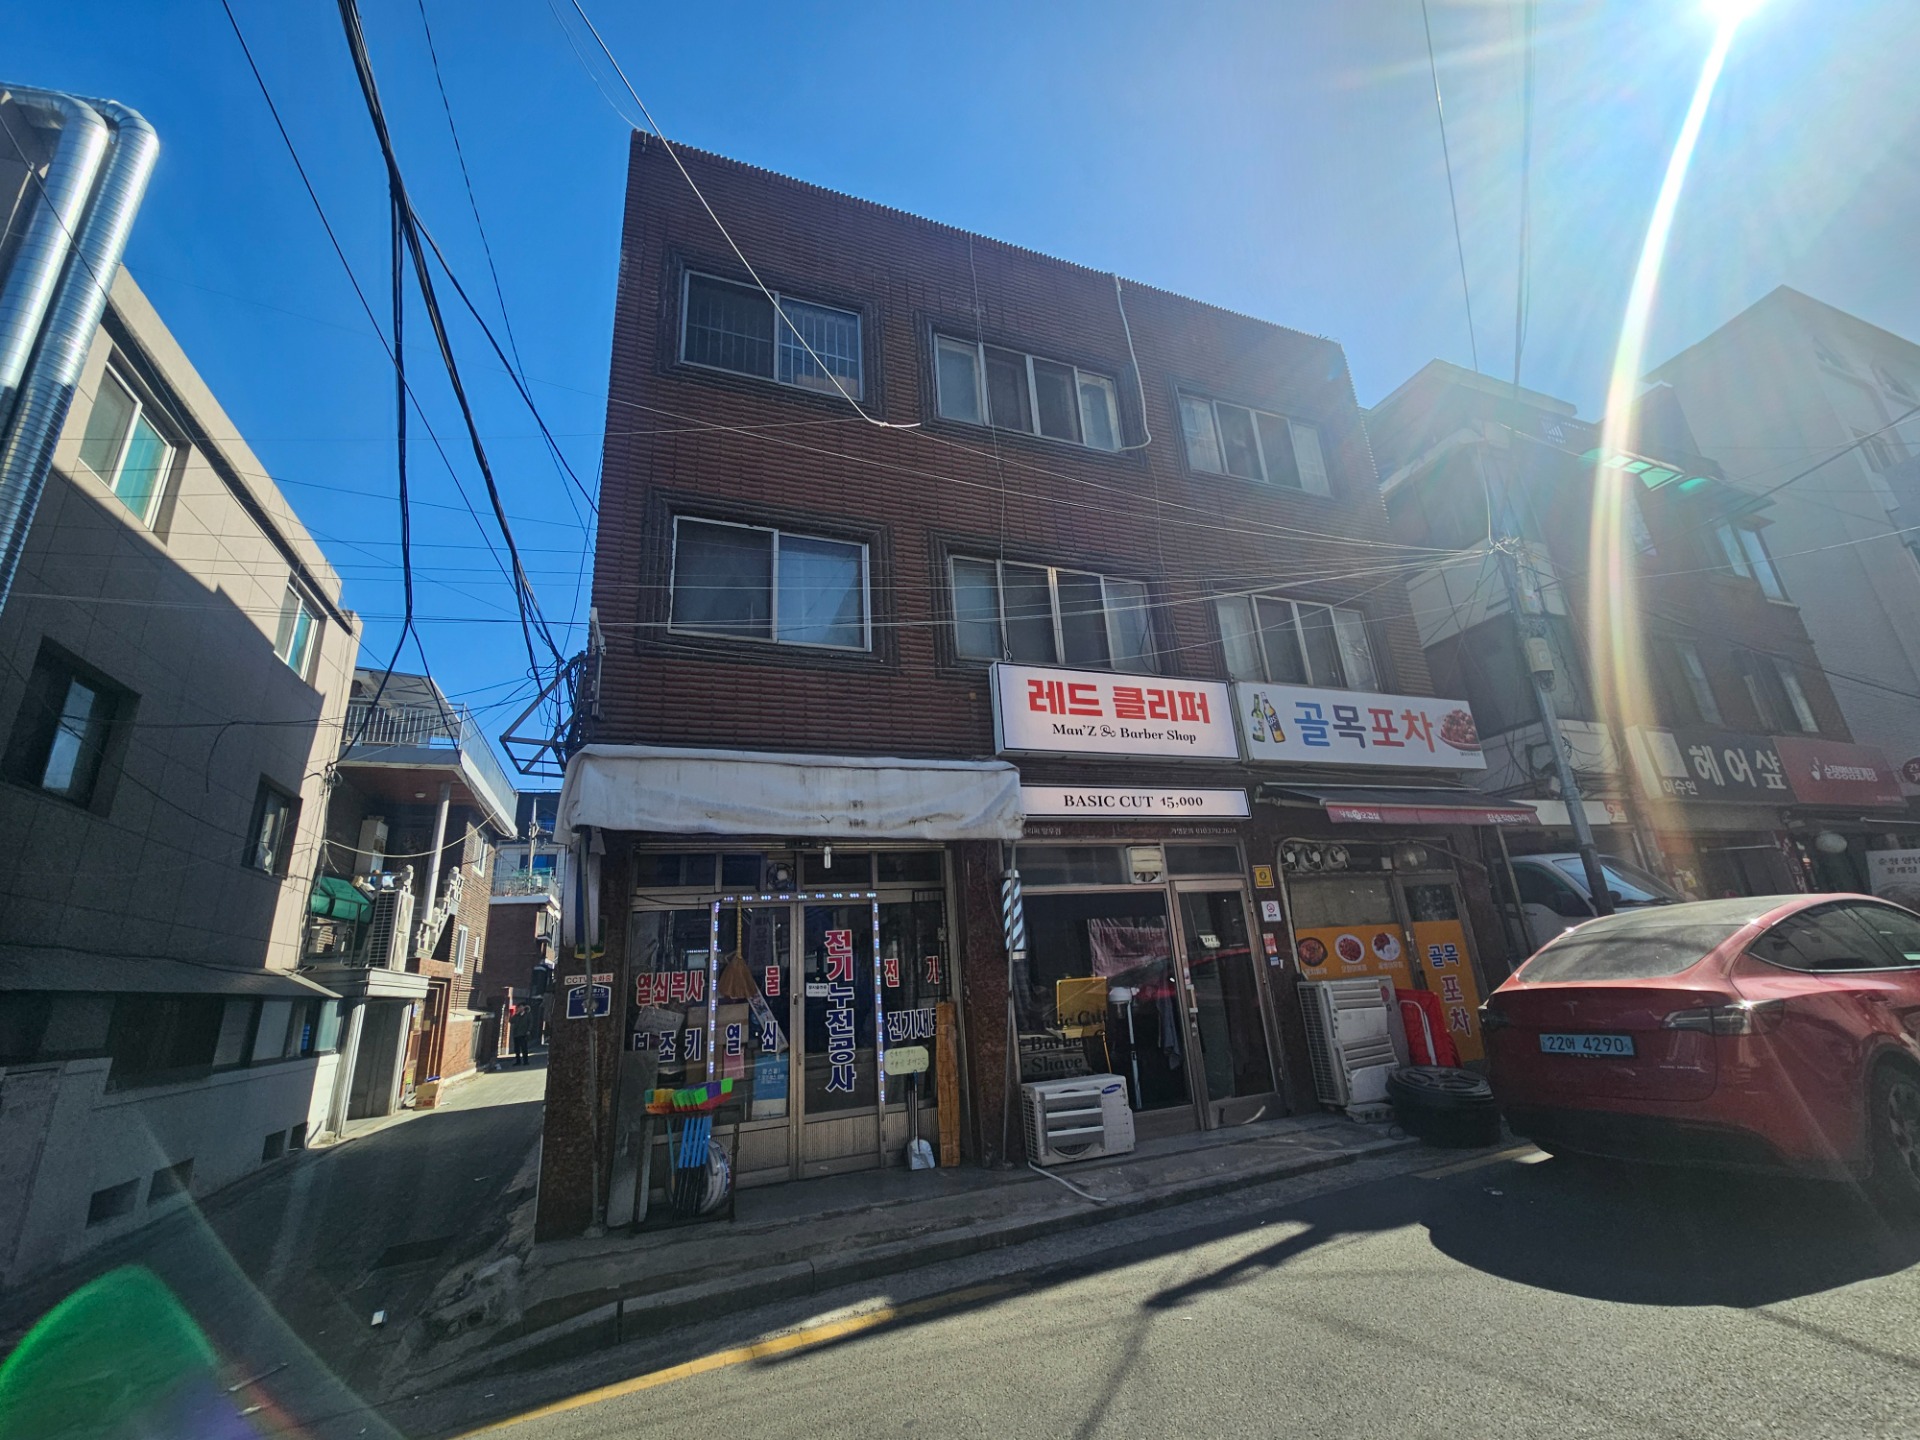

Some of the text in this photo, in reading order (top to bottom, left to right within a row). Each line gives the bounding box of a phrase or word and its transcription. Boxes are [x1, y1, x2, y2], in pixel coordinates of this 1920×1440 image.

[1027, 679, 1211, 724] 레드 클리퍼
[1120, 727, 1163, 741] Barber
[1166, 729, 1197, 745] Shop
[1293, 701, 1436, 753] 골목포차
[1662, 778, 1699, 796] 이수연
[1688, 744, 1787, 790] 헤어샵
[1063, 794, 1203, 809] BASIC CUT 15,000
[1428, 944, 1459, 969] 골목
[636, 970, 705, 1006] 열쇠복사
[1031, 1033, 1083, 1051] Barbe
[1547, 1036, 1624, 1053] 22어 4290
[1032, 1056, 1083, 1073] Shave
